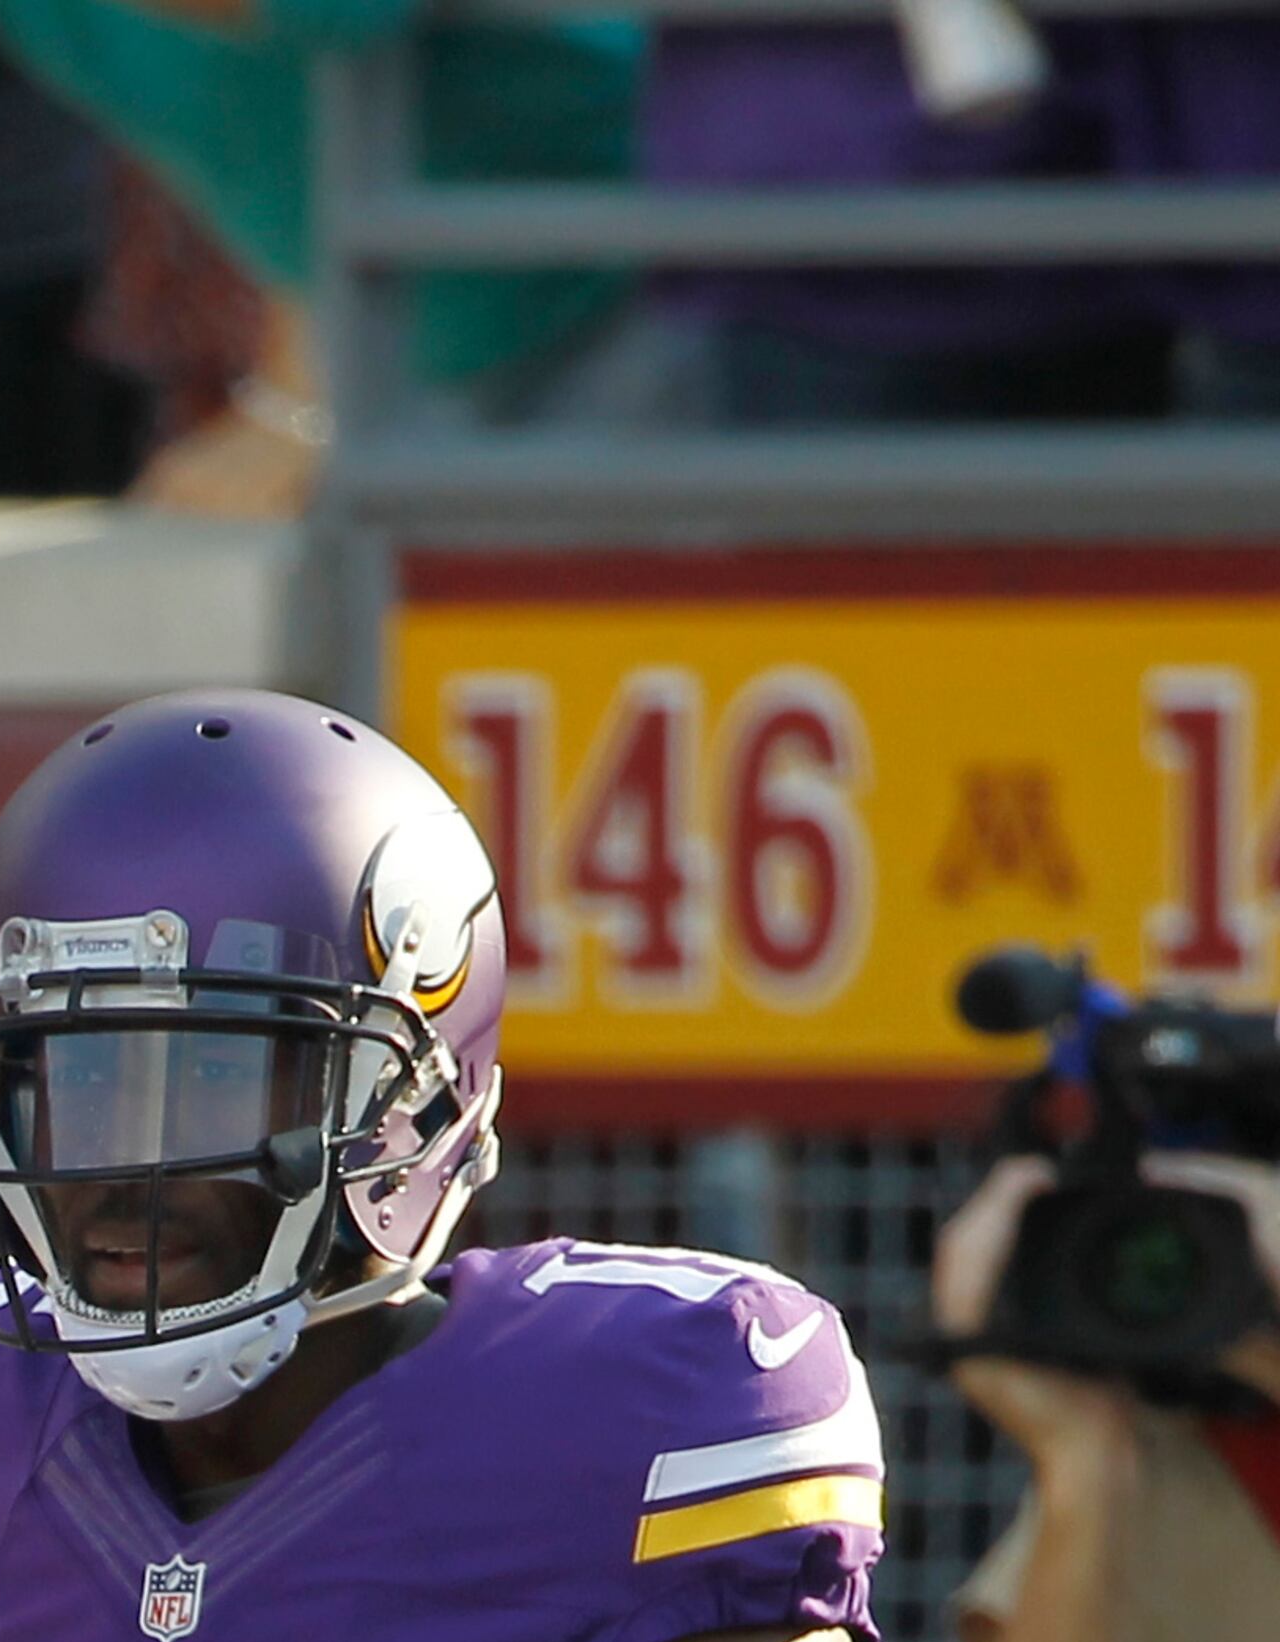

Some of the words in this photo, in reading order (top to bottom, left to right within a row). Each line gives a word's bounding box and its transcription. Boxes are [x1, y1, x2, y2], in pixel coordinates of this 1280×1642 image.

[444, 664, 874, 1012] 146
[1142, 664, 1280, 992] 1
[149, 1595, 190, 1630] NFL
